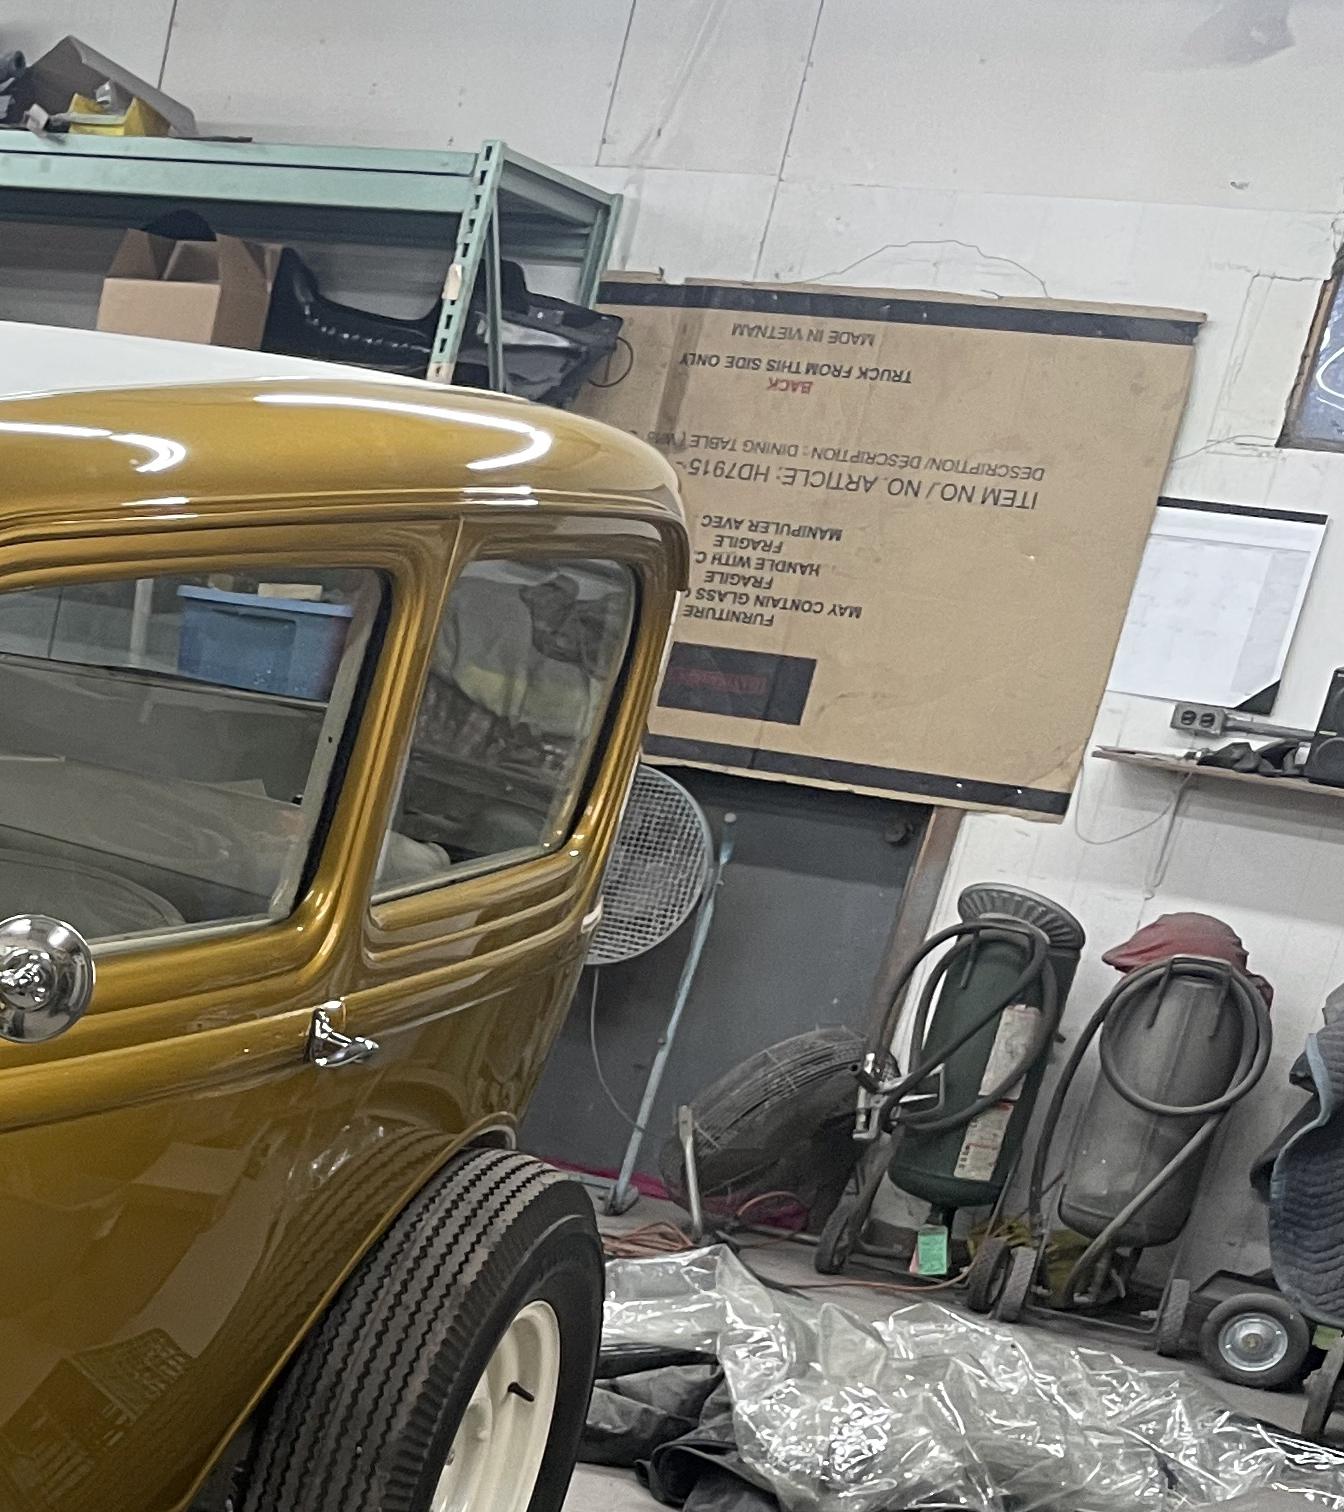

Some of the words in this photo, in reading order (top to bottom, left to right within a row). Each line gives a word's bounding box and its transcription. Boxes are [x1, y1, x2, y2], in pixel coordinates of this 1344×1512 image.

[731, 322, 802, 340] VIETNAM
[808, 328, 824, 342] IN
[827, 330, 875, 346] MADE
[678, 352, 720, 367] ONLY
[724, 355, 762, 370] SIDE
[766, 359, 802, 374] THIS
[804, 362, 853, 378] FROM
[855, 366, 912, 384] TRUCK
[766, 376, 812, 394] BACK
[688, 434, 736, 451] TABLE
[742, 439, 798, 456] DINING
[775, 466, 878, 492] ARTICLE:
[980, 486, 1038, 509] ITEM
[748, 520, 842, 541] MANIPULER
[712, 534, 783, 553] FRAGILE
[711, 552, 750, 568] WITH
[756, 557, 820, 576] HANDLE
[704, 570, 773, 589] FRAGILE
[695, 588, 749, 605] GLASS
[754, 594, 824, 614] CONTAIN
[682, 604, 774, 626] FURNITURE
[826, 603, 862, 618] MAY
